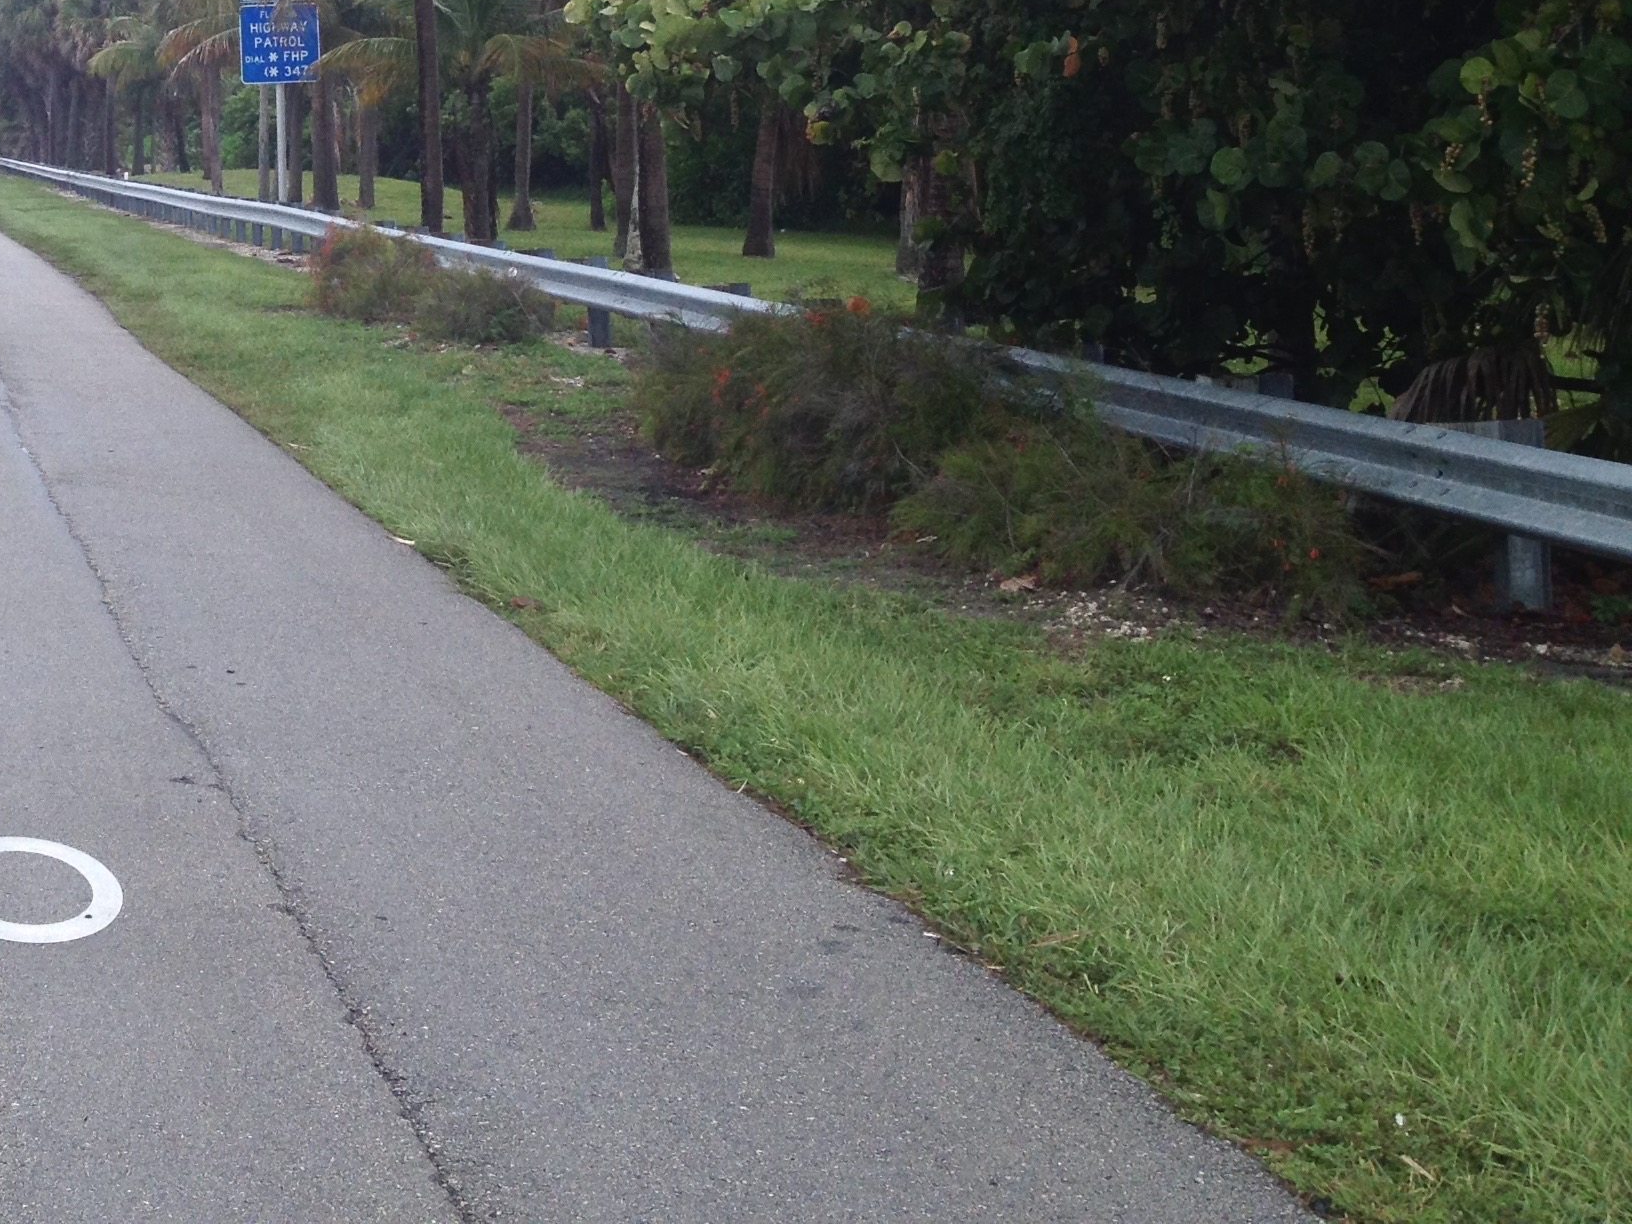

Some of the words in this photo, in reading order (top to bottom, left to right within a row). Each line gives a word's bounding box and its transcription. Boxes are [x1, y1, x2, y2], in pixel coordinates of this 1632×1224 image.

[254, 36, 305, 48] PATROL
[245, 55, 265, 63] DIAL
[283, 50, 309, 62] FHP
